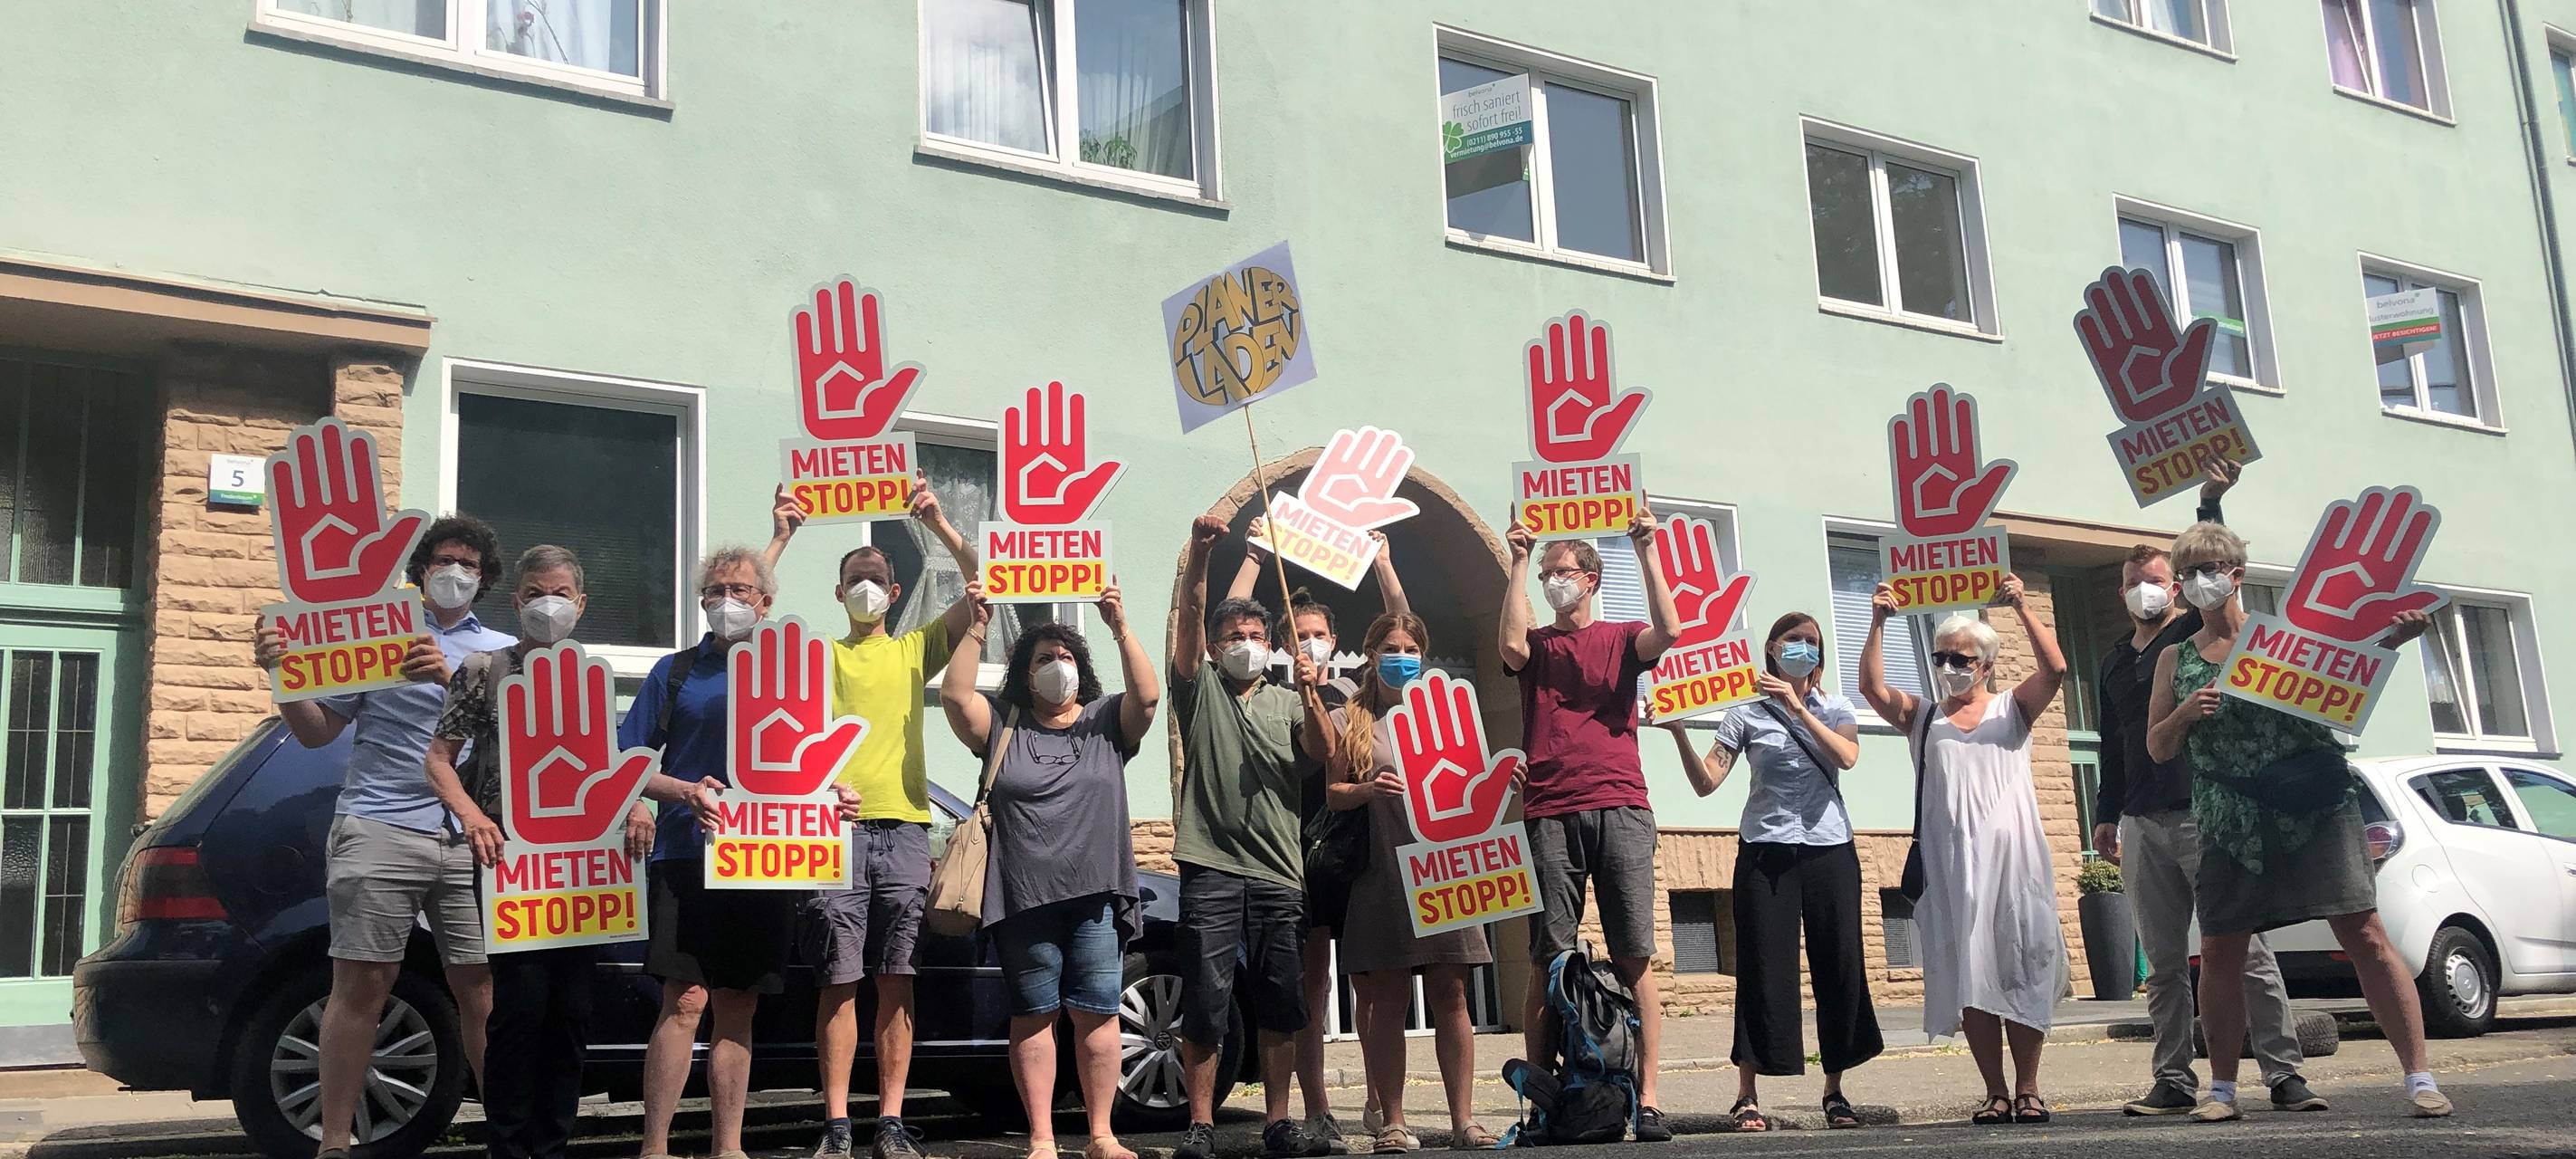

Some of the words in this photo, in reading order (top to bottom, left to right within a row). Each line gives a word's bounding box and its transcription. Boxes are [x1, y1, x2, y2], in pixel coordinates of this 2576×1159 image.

[1453, 100, 1480, 119] frisch
[1484, 91, 1521, 110] saniert
[1467, 112, 1498, 132] sofort
[1501, 106, 1522, 124] frei!
[1466, 135, 1486, 148] (0211)
[1174, 267, 1299, 364] PLANER
[2376, 298, 2415, 309] belvona
[1176, 312, 1301, 406] LADEN
[2120, 397, 2231, 465] MIETEN
[232, 470, 244, 487] 5
[791, 444, 907, 479] MIETEN
[1522, 464, 1632, 499] MIETEN
[2136, 427, 2247, 494] STOPP!
[795, 479, 909, 515] STOPP!
[1525, 498, 1634, 532] STOPP!
[990, 531, 1102, 559] MIETEN
[1275, 502, 1372, 559] MIETEN
[1890, 536, 1999, 573] MIETEN
[988, 564, 1102, 594] STOPP!
[276, 600, 414, 649] MIETEN
[281, 640, 414, 690] STOPP
[1651, 639, 1751, 685] MIETEN
[2246, 624, 2382, 687] MIETEN
[1655, 668, 1758, 714] STOPP!
[2230, 657, 2365, 722] STOPP!
[718, 801, 841, 837] MIETEN
[495, 848, 633, 893] MIETEN
[717, 842, 841, 878] STOPP!
[1408, 835, 1522, 886] MIETEN
[497, 892, 635, 940] STOPP!
[1418, 872, 1531, 924] STOPP!
